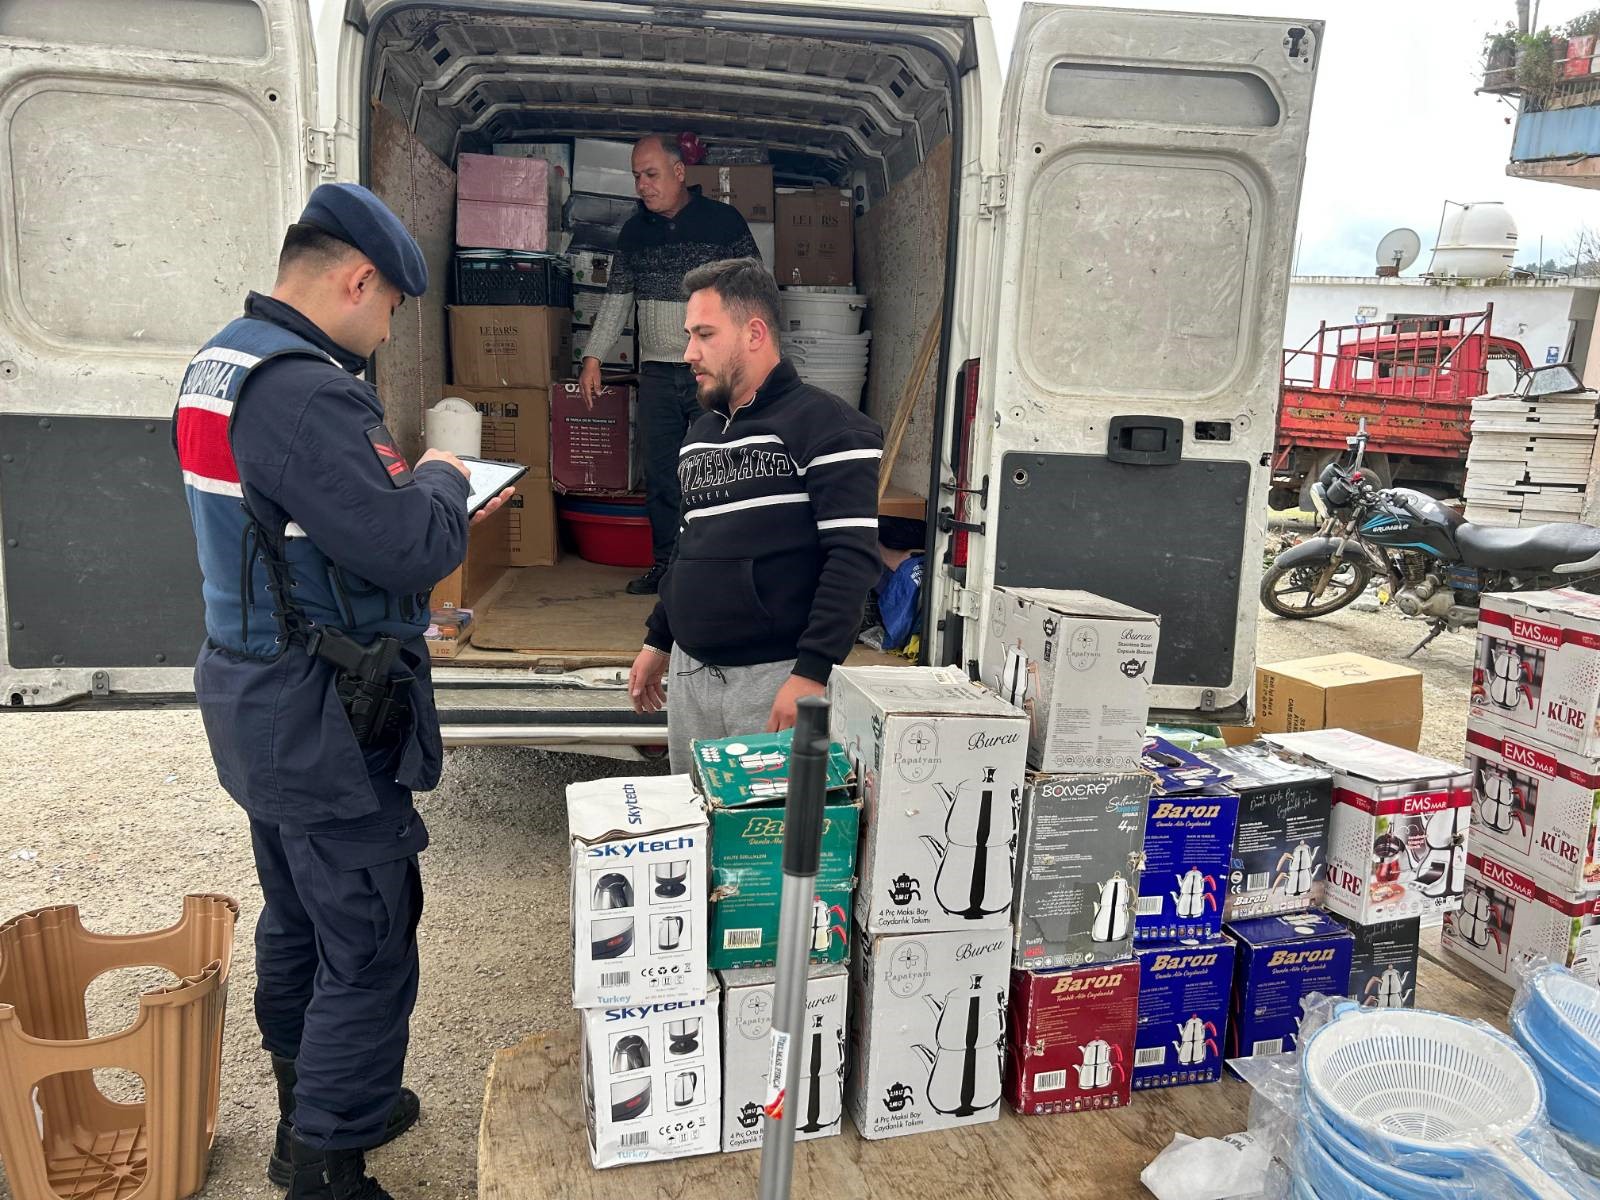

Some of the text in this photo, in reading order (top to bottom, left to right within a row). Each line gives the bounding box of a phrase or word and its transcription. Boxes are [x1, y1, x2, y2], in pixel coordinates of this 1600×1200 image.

[686, 489, 730, 506] GENEVA
[1120, 628, 1153, 641] Burcu
[1513, 621, 1559, 645] EMS MAR
[1547, 701, 1587, 730] KÜRE
[967, 731, 1022, 751] Burcu
[1504, 743, 1554, 775] EMS MAR
[1041, 783, 1108, 798] BONERA
[622, 783, 643, 825] Skytech
[1151, 803, 1221, 819] Baron
[1404, 797, 1448, 812] EMS MAR
[587, 836, 695, 859] Skytech
[1540, 832, 1580, 864] KÜRE
[1326, 862, 1363, 897] KÜRE
[1483, 861, 1533, 898] EMS MAR
[1233, 894, 1268, 907] Baron
[916, 907, 929, 917] Boy
[954, 939, 1005, 962] Burcu
[1266, 948, 1336, 967] Baron
[1149, 953, 1218, 972] Baron
[1050, 973, 1123, 995] Baron
[597, 995, 631, 1004] Turkey
[805, 993, 839, 1010] urcu
[735, 1016, 773, 1027] Papatya
[617, 1150, 649, 1160] Turkey
